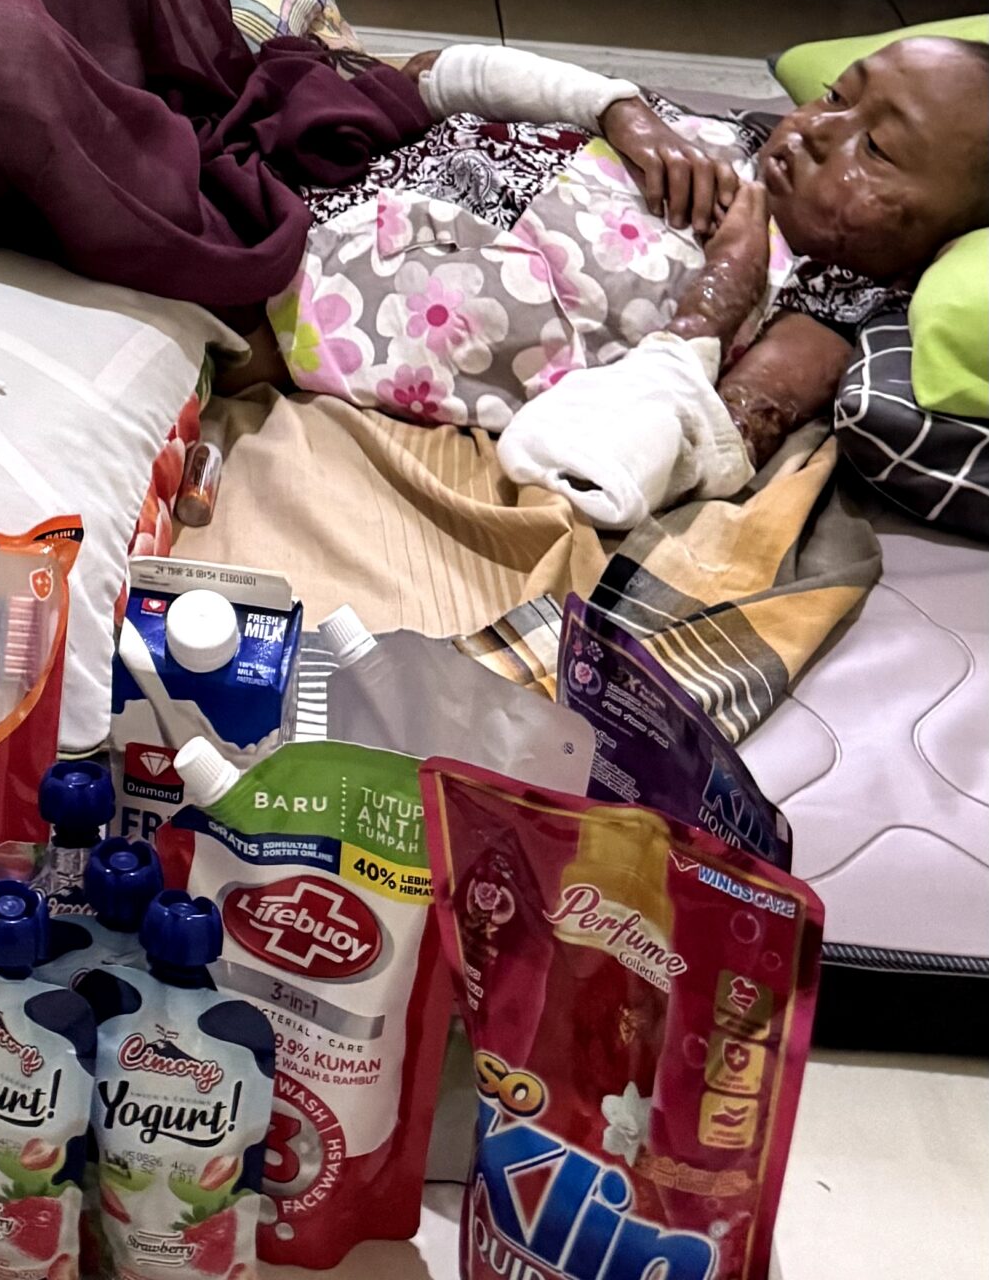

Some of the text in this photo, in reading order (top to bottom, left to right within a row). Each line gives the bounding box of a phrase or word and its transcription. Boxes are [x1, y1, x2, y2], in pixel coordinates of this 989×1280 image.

[244, 622, 284, 642] MILK
[247, 613, 279, 626] FRESH
[126, 782, 181, 801] Diamond
[255, 792, 328, 812] BARU
[361, 787, 425, 818] TUTUP
[208, 820, 259, 856] GRATIS
[357, 822, 419, 853] TUMPAH
[358, 806, 420, 840] ANTI
[697, 807, 741, 850] LIQUID
[262, 841, 317, 851] KONSULTASI
[262, 849, 299, 858] DOKTER
[353, 858, 397, 890] 40%
[400, 874, 432, 886] LEBIH
[236, 893, 372, 962] Lifebuoy
[543, 883, 688, 977] Perfume
[618, 950, 672, 994] Collection
[270, 981, 319, 1018] 3-in-1
[275, 1032, 382, 1074] 9.9% KUMAN
[328, 1038, 364, 1054] CARE
[118, 1033, 224, 1094] Cimory
[282, 1057, 320, 1081] WAJAH
[333, 1074, 380, 1087] RAMBUT
[278, 1077, 329, 1123] WASH
[474, 1050, 548, 1118] SO
[98, 1080, 243, 1148] Yogurt!
[281, 1138, 343, 1214] FACEWASH
[124, 1234, 196, 1263] Strawberry
